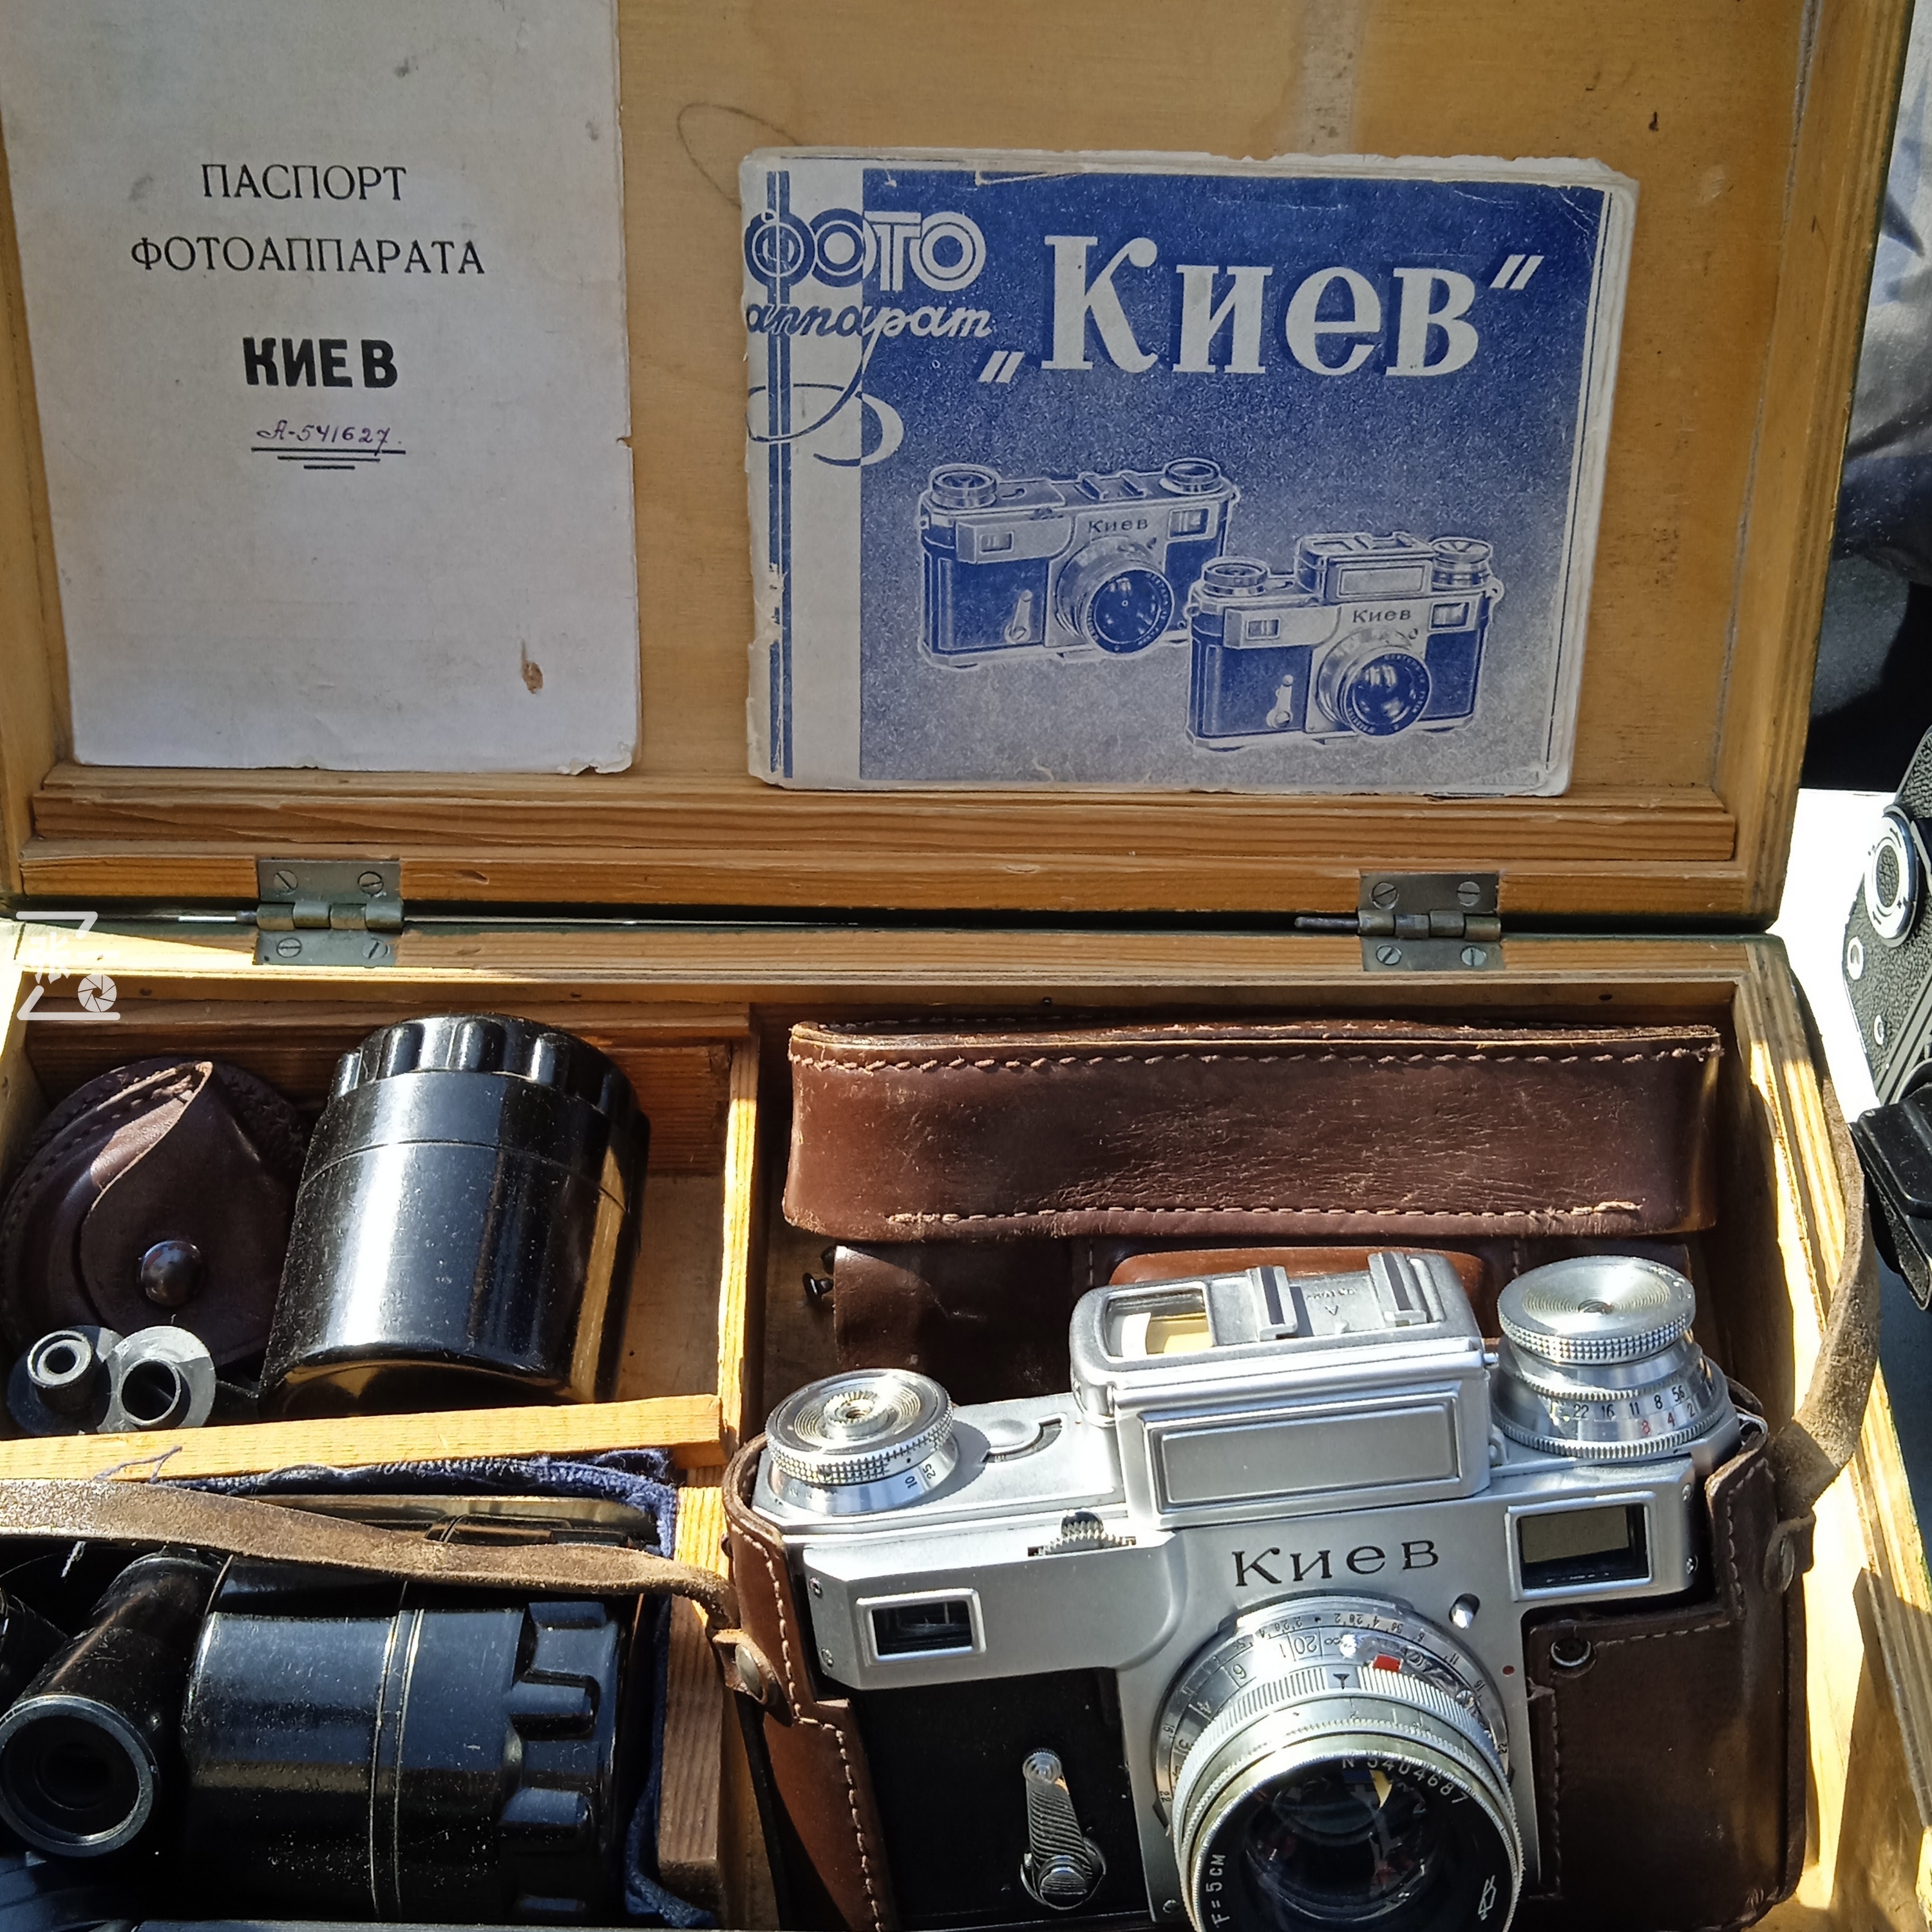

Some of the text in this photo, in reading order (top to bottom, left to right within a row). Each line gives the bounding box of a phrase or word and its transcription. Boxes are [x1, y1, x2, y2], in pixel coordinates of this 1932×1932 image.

[201, 164, 407, 201] ПАСПОРТ
[131, 236, 486, 274] ФОТОАППАРАТА
[744, 207, 987, 292] ФОТО
[242, 336, 399, 389] КИЕВ
[1088, 518, 1148, 534] Киев
[1352, 609, 1412, 623] Киев
[1573, 1403, 1589, 1419] 22
[1600, 1403, 1616, 1421] 16
[1629, 1401, 1641, 1416] 11
[1653, 1394, 1663, 1410] 8
[1687, 1403, 1696, 1418] 2
[904, 1475, 918, 1489] 10
[922, 1463, 937, 1480] 25
[1231, 1539, 1440, 1588] Киев
[1333, 1612, 1341, 1624] 2
[1293, 1634, 1318, 1655] 20
